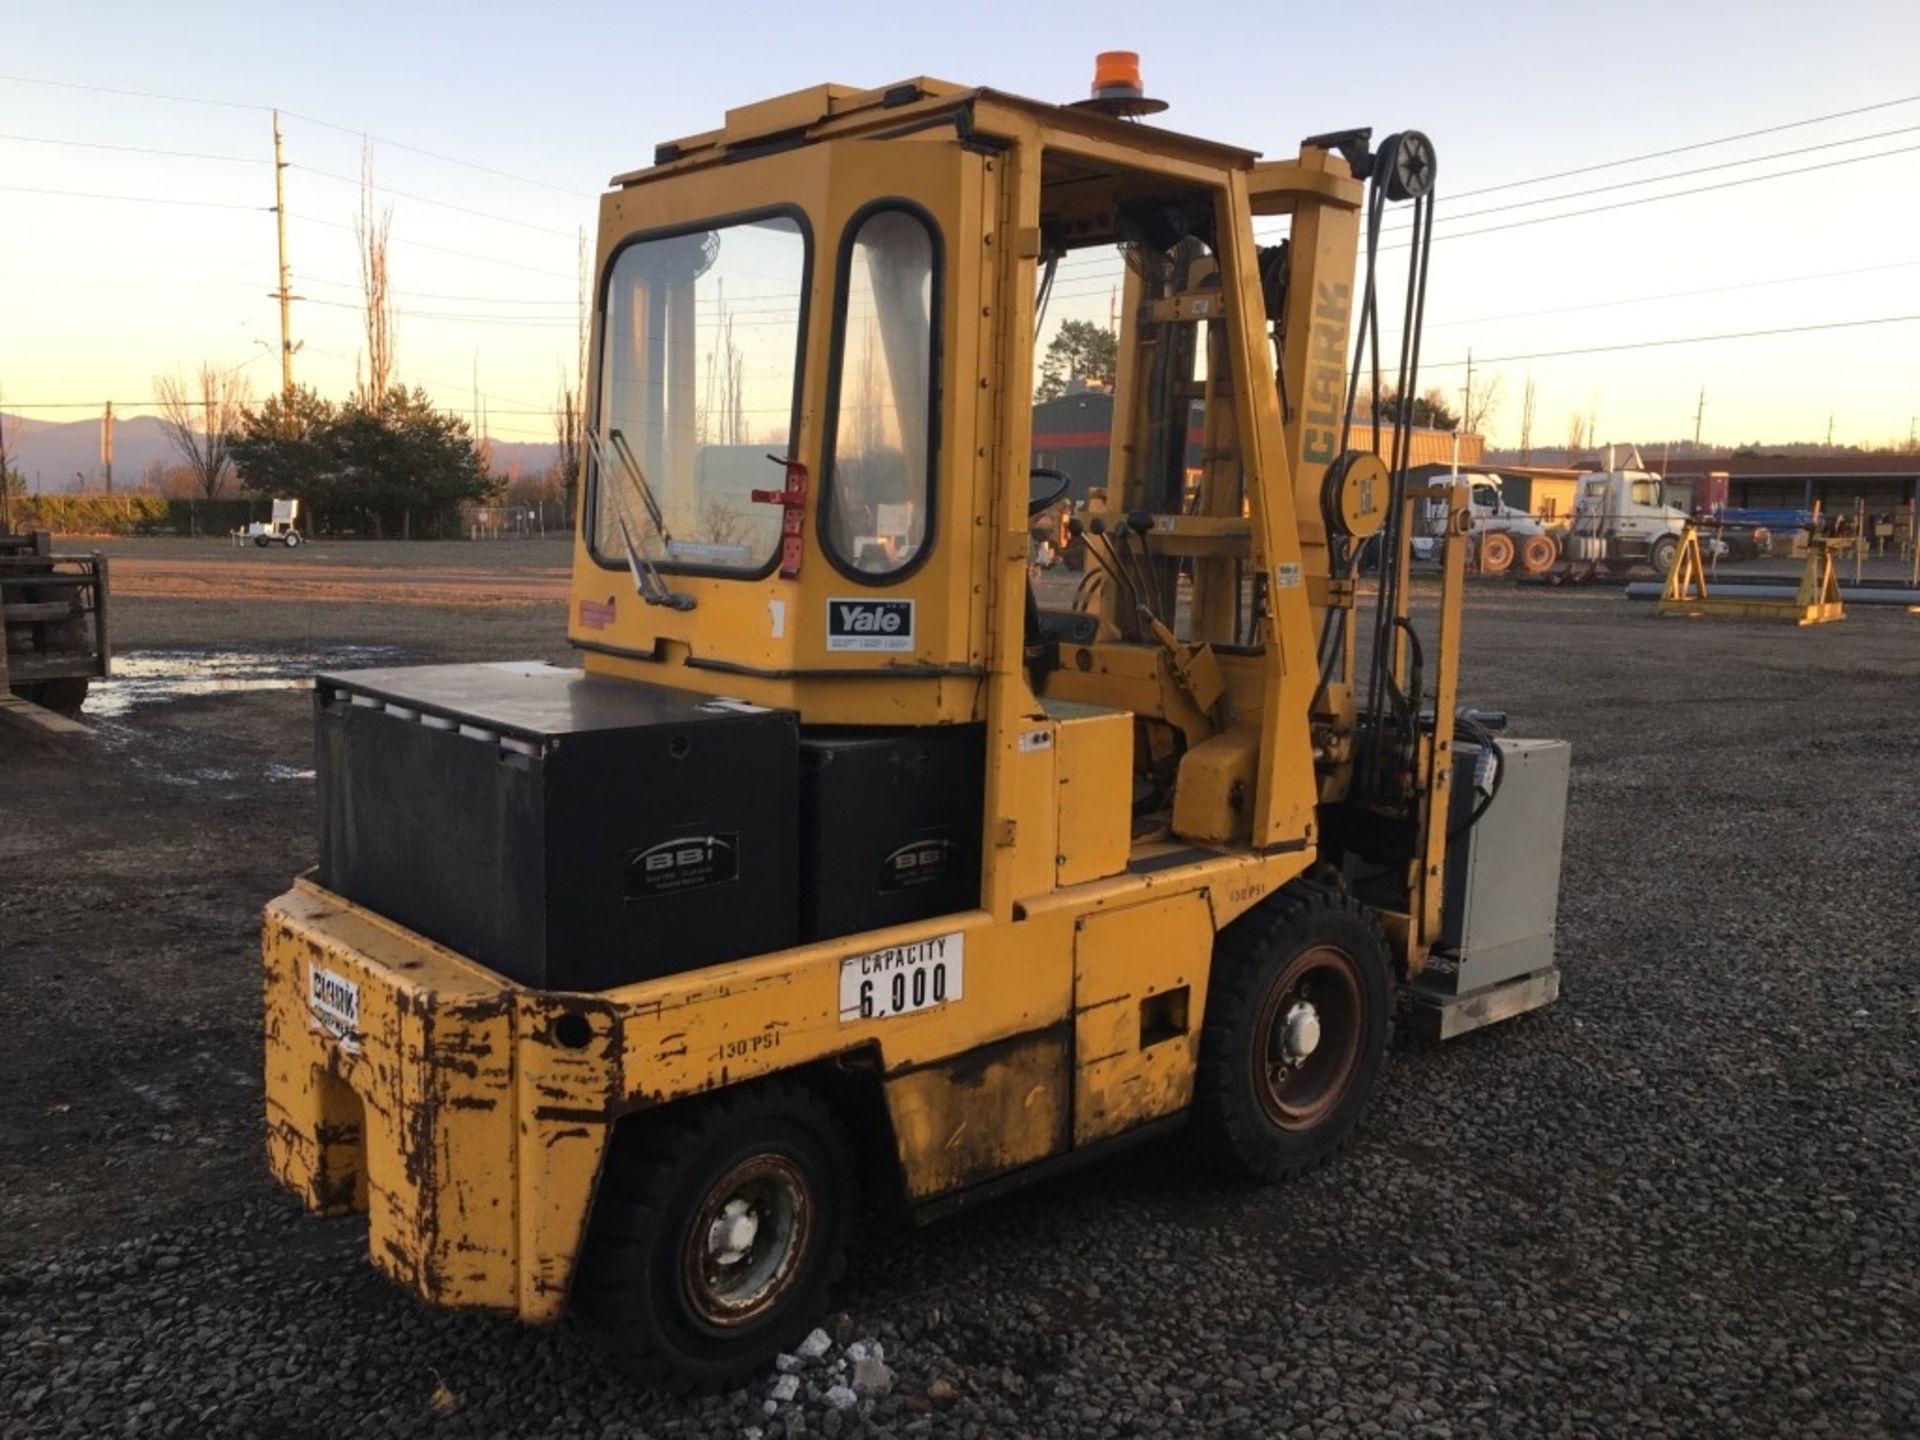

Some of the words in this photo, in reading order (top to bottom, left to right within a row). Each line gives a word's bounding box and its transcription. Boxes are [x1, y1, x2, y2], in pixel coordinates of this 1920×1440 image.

[1303, 282, 1349, 464] CLARK
[840, 606, 901, 632] Yale
[861, 939, 945, 976] CAPACITY
[860, 963, 945, 1018] 6,000
[719, 1040, 747, 1060] 130
[752, 1031, 779, 1053] PSI
